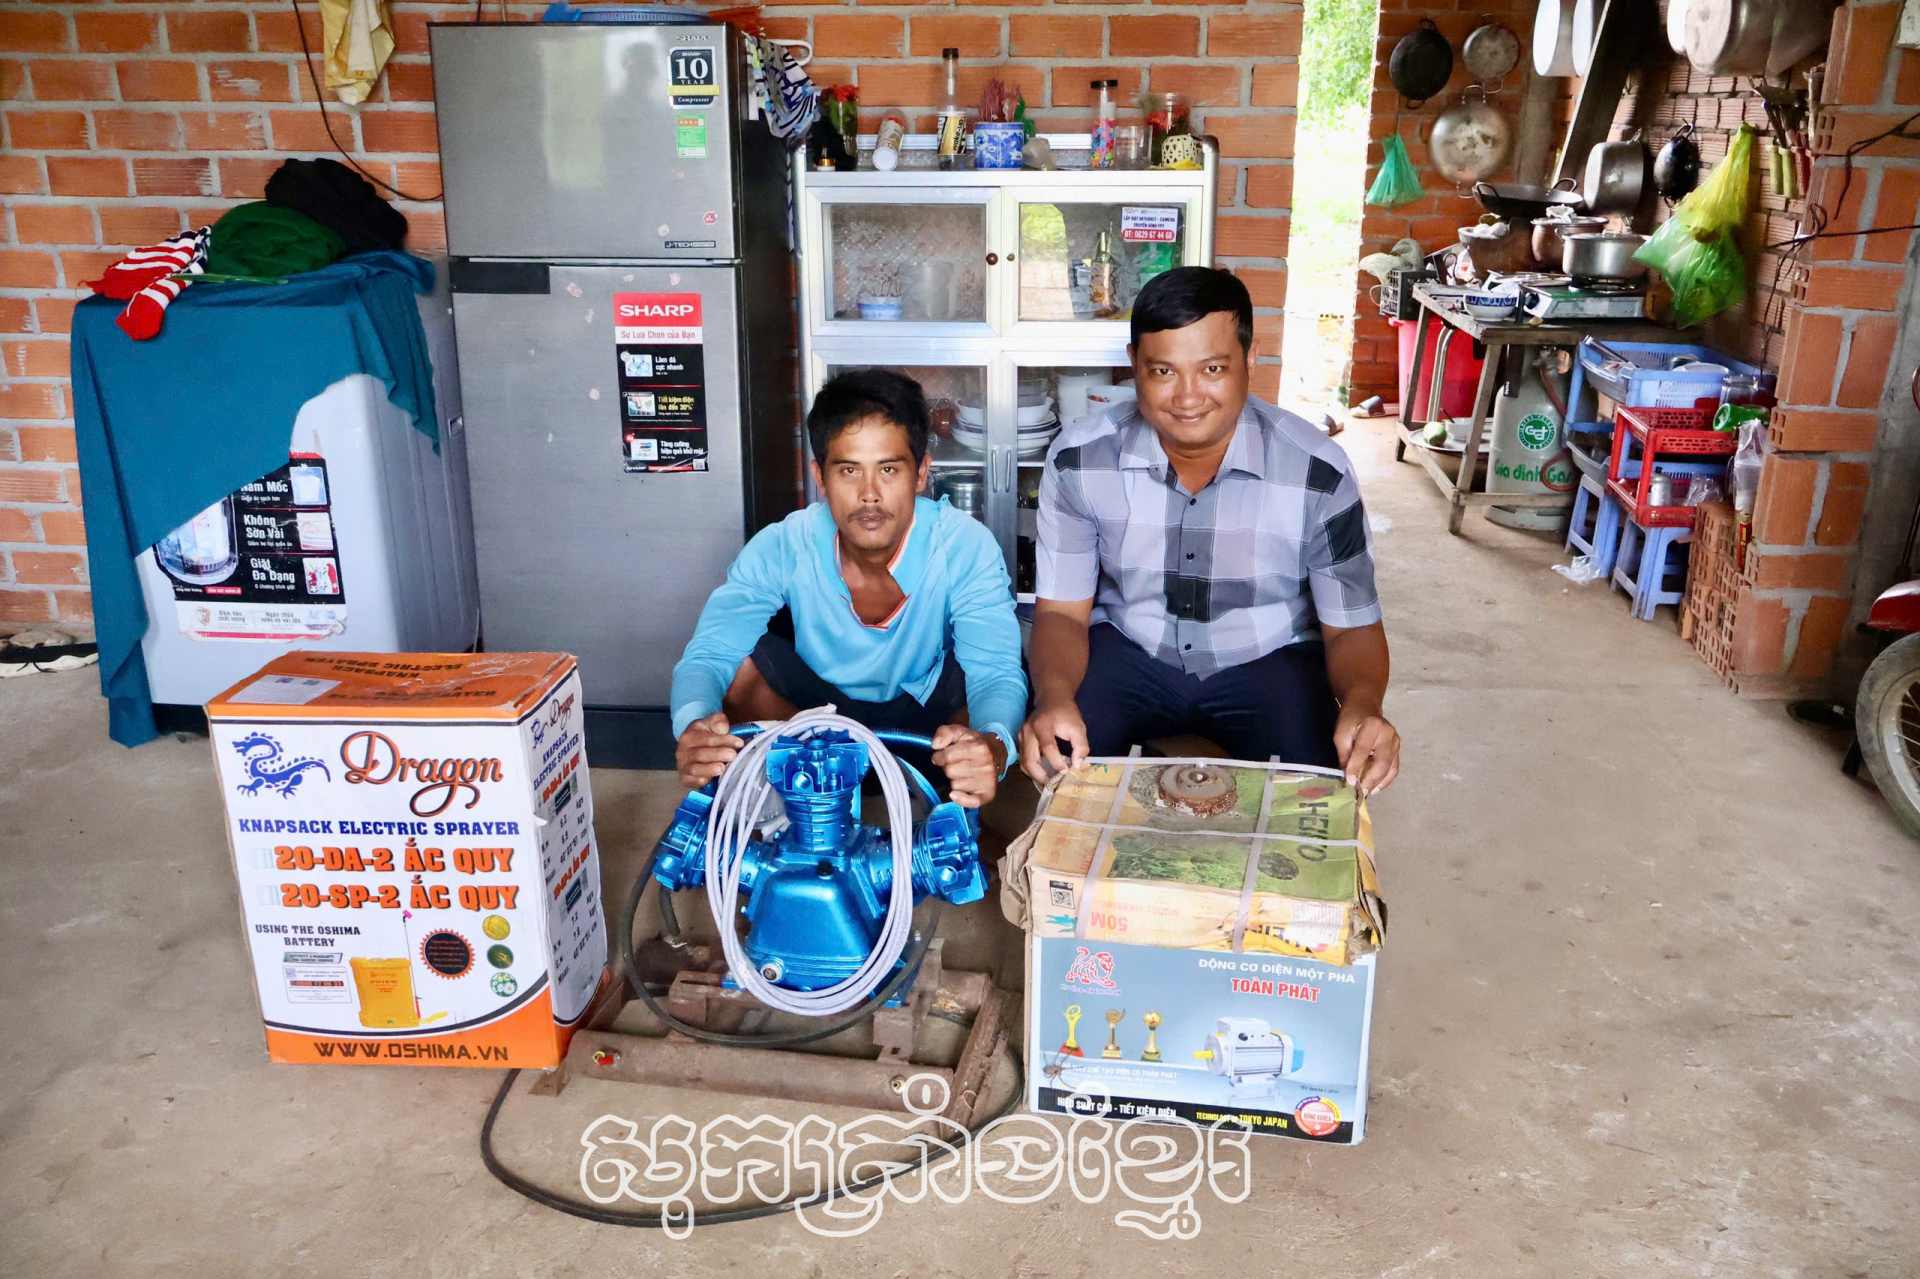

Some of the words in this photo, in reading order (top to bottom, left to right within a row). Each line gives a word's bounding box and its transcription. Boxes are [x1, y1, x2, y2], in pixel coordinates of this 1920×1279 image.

[675, 58, 708, 79] 10
[952, 118, 965, 151] wake-up
[1157, 231, 1164, 239] 44
[620, 304, 694, 316] SHARP
[632, 330, 645, 339] Lựa
[648, 330, 665, 339] Chọn
[667, 330, 679, 338] của
[682, 330, 696, 339] Bạn
[266, 480, 289, 492] Mốc
[243, 514, 276, 528] Không
[246, 526, 266, 539] Sờn
[267, 527, 284, 539] Vải
[250, 558, 272, 570] Giặt
[252, 570, 266, 580] Đa
[270, 570, 295, 583] Dạng
[304, 657, 381, 668] SPRAYER
[383, 662, 464, 672] ELECTRIC
[332, 665, 421, 678] KNAPSACK
[550, 691, 574, 729] Dragon
[542, 729, 567, 764] KNAPSACK
[533, 757, 556, 790] ELECTRIC
[557, 732, 578, 763] SPRAYER
[340, 730, 504, 817] Dragon
[239, 819, 333, 833] KNAPSACK
[339, 821, 428, 835] ELECTRIC
[434, 822, 520, 835] SPRAYER
[274, 846, 394, 871] 20-DA-2
[404, 837, 446, 872] ẮC
[452, 848, 514, 874] QUY
[280, 883, 400, 908] 20-SP-2
[410, 874, 451, 909] ẮC
[458, 885, 519, 912] QUY
[255, 924, 288, 934] USING
[292, 926, 314, 934] THE
[318, 926, 361, 935] OSHIMA
[1091, 912, 1128, 932] 50M
[284, 937, 335, 946] BATTERY
[1199, 958, 1236, 972] ĐỘNG
[1240, 962, 1258, 972] CƠ
[1262, 962, 1292, 977] ĐIỆN
[1296, 966, 1325, 982] MỘT
[1328, 971, 1355, 984] PHA
[1231, 977, 1274, 996] TOÀN
[1278, 983, 1320, 1002] PHÁT
[314, 1042, 509, 1061] WWW.OSHIMA.VN
[1087, 1065, 1100, 1073] CHẾ
[1142, 1069, 1160, 1077] TOÀN
[1160, 1070, 1178, 1078] PHÁT
[1057, 1096, 1074, 1108] HIỆU
[1076, 1099, 1095, 1112] SUẤT
[1097, 1102, 1112, 1113] CAO
[1119, 1102, 1135, 1115] TIẾT
[1136, 1104, 1157, 1118] KIỆM
[1158, 1106, 1176, 1119] ĐIỆN
[1196, 1112, 1230, 1122] TECHNOLOGY
[1239, 1114, 1262, 1124] TOKYO
[1263, 1117, 1288, 1128] JAPAN
